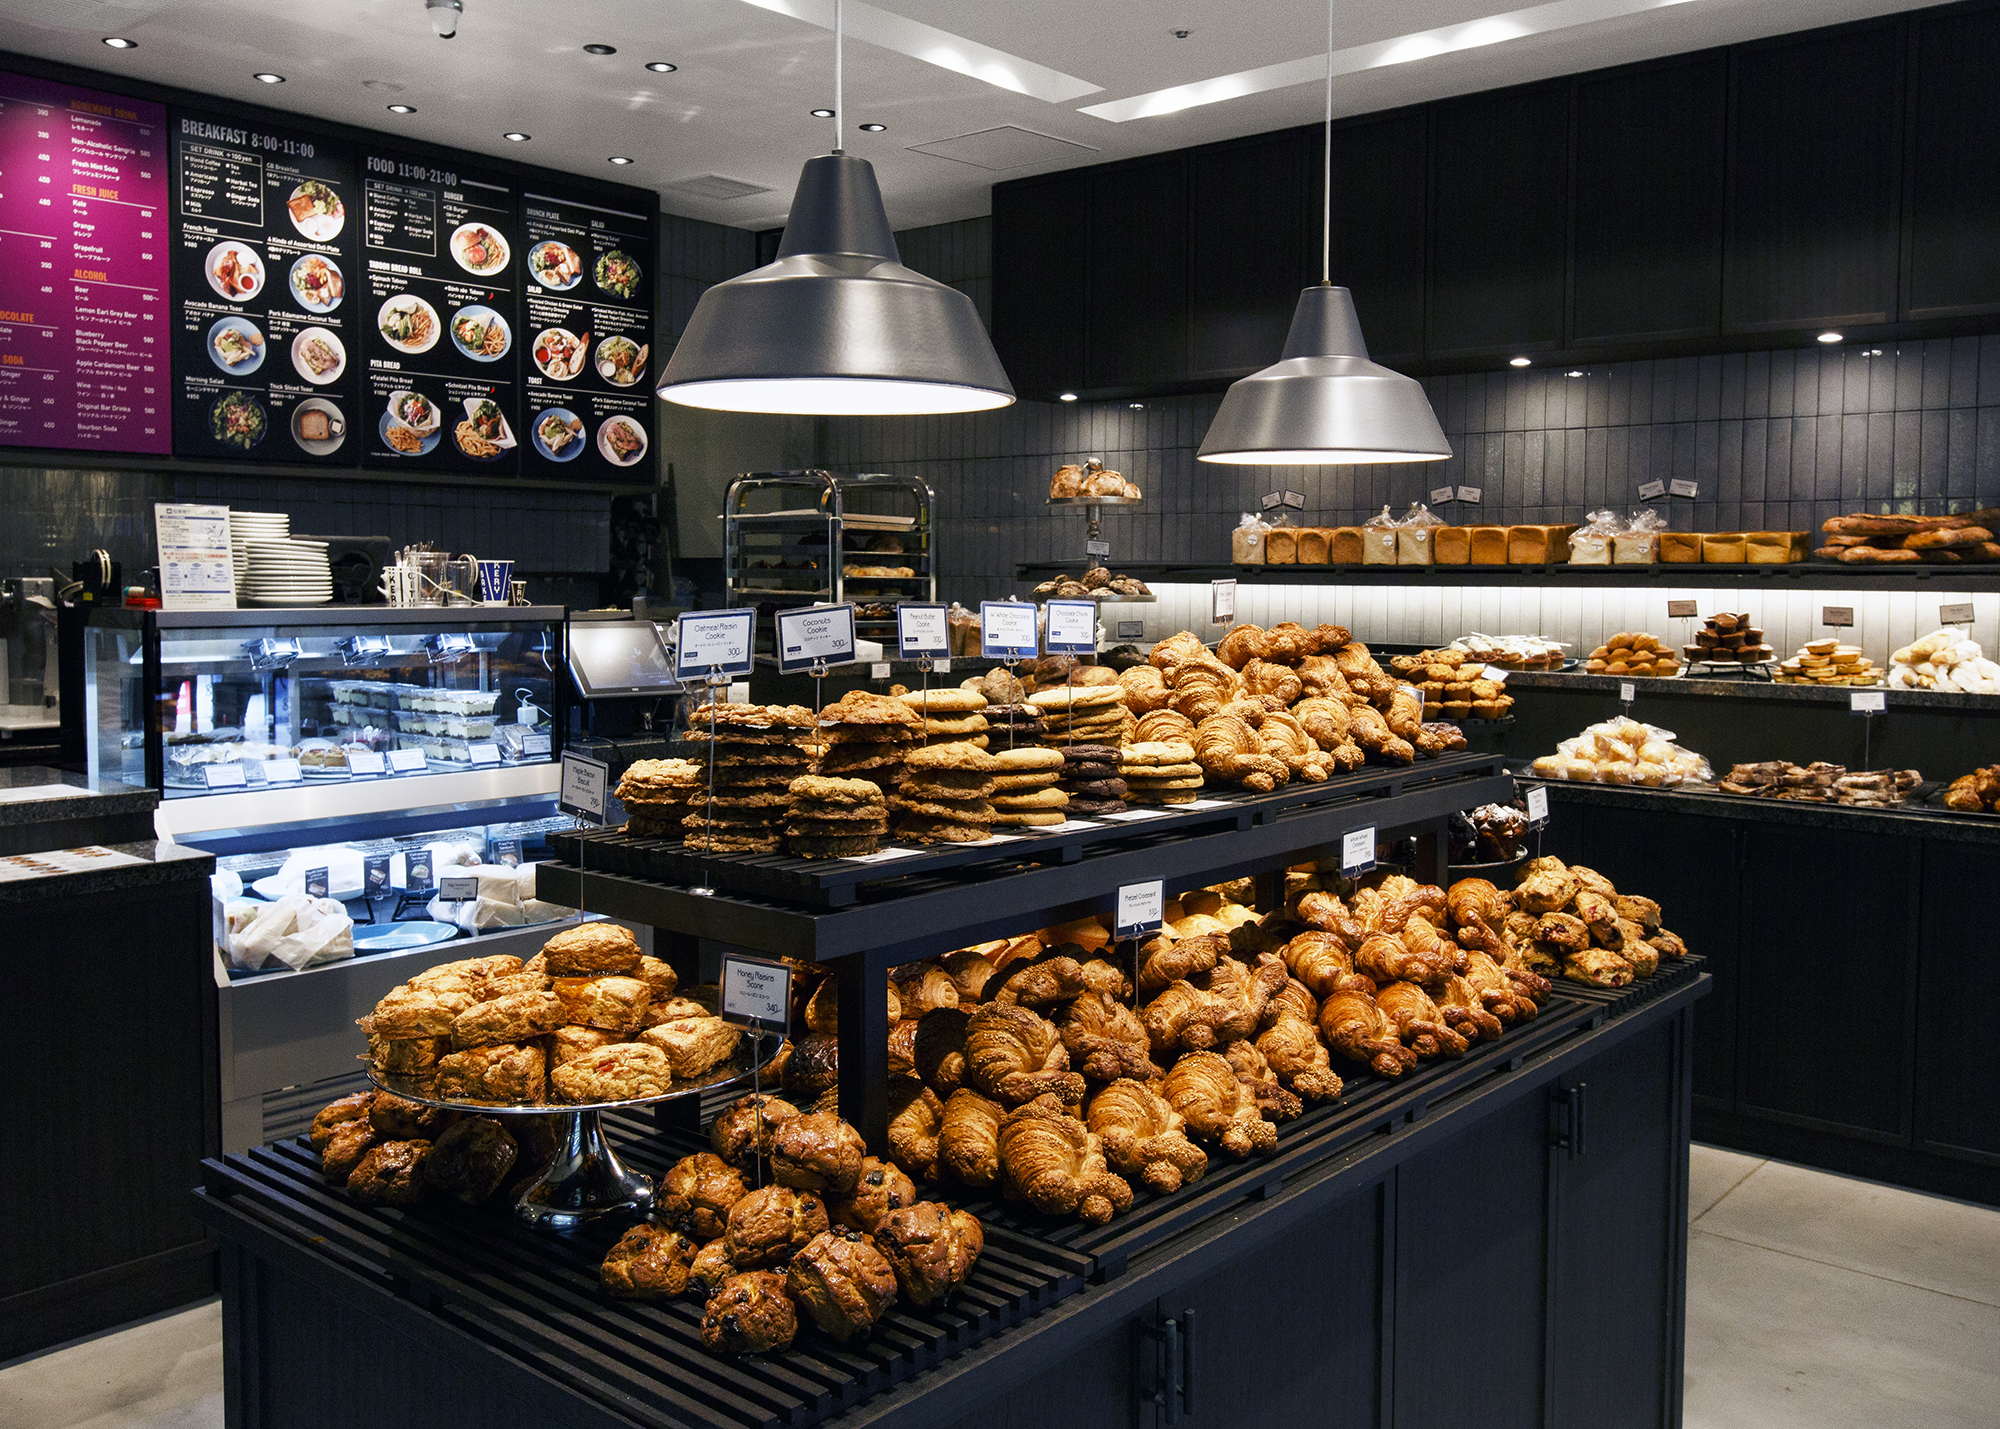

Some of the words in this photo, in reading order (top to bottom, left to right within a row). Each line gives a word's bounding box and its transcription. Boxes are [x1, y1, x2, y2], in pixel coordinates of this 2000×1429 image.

[115, 110, 137, 120] DRINK
[71, 115, 101, 126] Lemonade
[182, 119, 247, 144] BREAKFAST
[252, 133, 314, 158] 8:00-11:00
[71, 137, 112, 150] Non-Alcoholic
[114, 145, 136, 155] Sangria
[204, 148, 224, 157] DRINK
[72, 160, 89, 169] Fresh
[90, 163, 103, 171] Mint
[276, 163, 299, 173] Breakfast
[367, 156, 395, 174] FOOD
[399, 162, 457, 186] 11:00-21:00
[190, 172, 218, 181] Americano
[72, 184, 96, 196] FRESH
[98, 188, 118, 200] JUICE
[190, 186, 215, 195] Espresso
[231, 193, 247, 202] Ginger
[444, 191, 463, 201] BURGER
[73, 199, 87, 207] Kale
[546, 212, 560, 221] PLATE
[73, 222, 95, 230] Orange
[183, 223, 202, 232] French
[204, 226, 218, 234] Toast
[74, 244, 103, 253] Grapefruit
[294, 241, 315, 250] Assorted
[369, 260, 390, 271] TABOON
[391, 264, 408, 274] BREAD
[74, 269, 108, 281] ALCOHOL
[372, 275, 390, 284] Spinach
[527, 285, 542, 294] SALAD
[185, 300, 207, 309] Avocado
[208, 302, 228, 311] Banana
[75, 306, 95, 314] Lemon
[110, 310, 123, 318] Grey
[94, 340, 113, 349] Pepper
[3, 355, 24, 365] SODA
[370, 359, 382, 368] PITA
[383, 361, 400, 370] BREAD
[94, 361, 125, 370] Cardamom
[1, 370, 21, 378] Ginger
[186, 376, 208, 384] Morning
[77, 403, 99, 411] Original
[803, 618, 831, 626] Coconuts
[694, 624, 718, 632] Oatmeal
[832, 639, 844, 647] 300
[728, 648, 740, 656] 300
[737, 969, 754, 980] Honey
[755, 971, 774, 982] Raisins
[747, 980, 763, 990] Scone
[766, 1003, 778, 1011] 340
